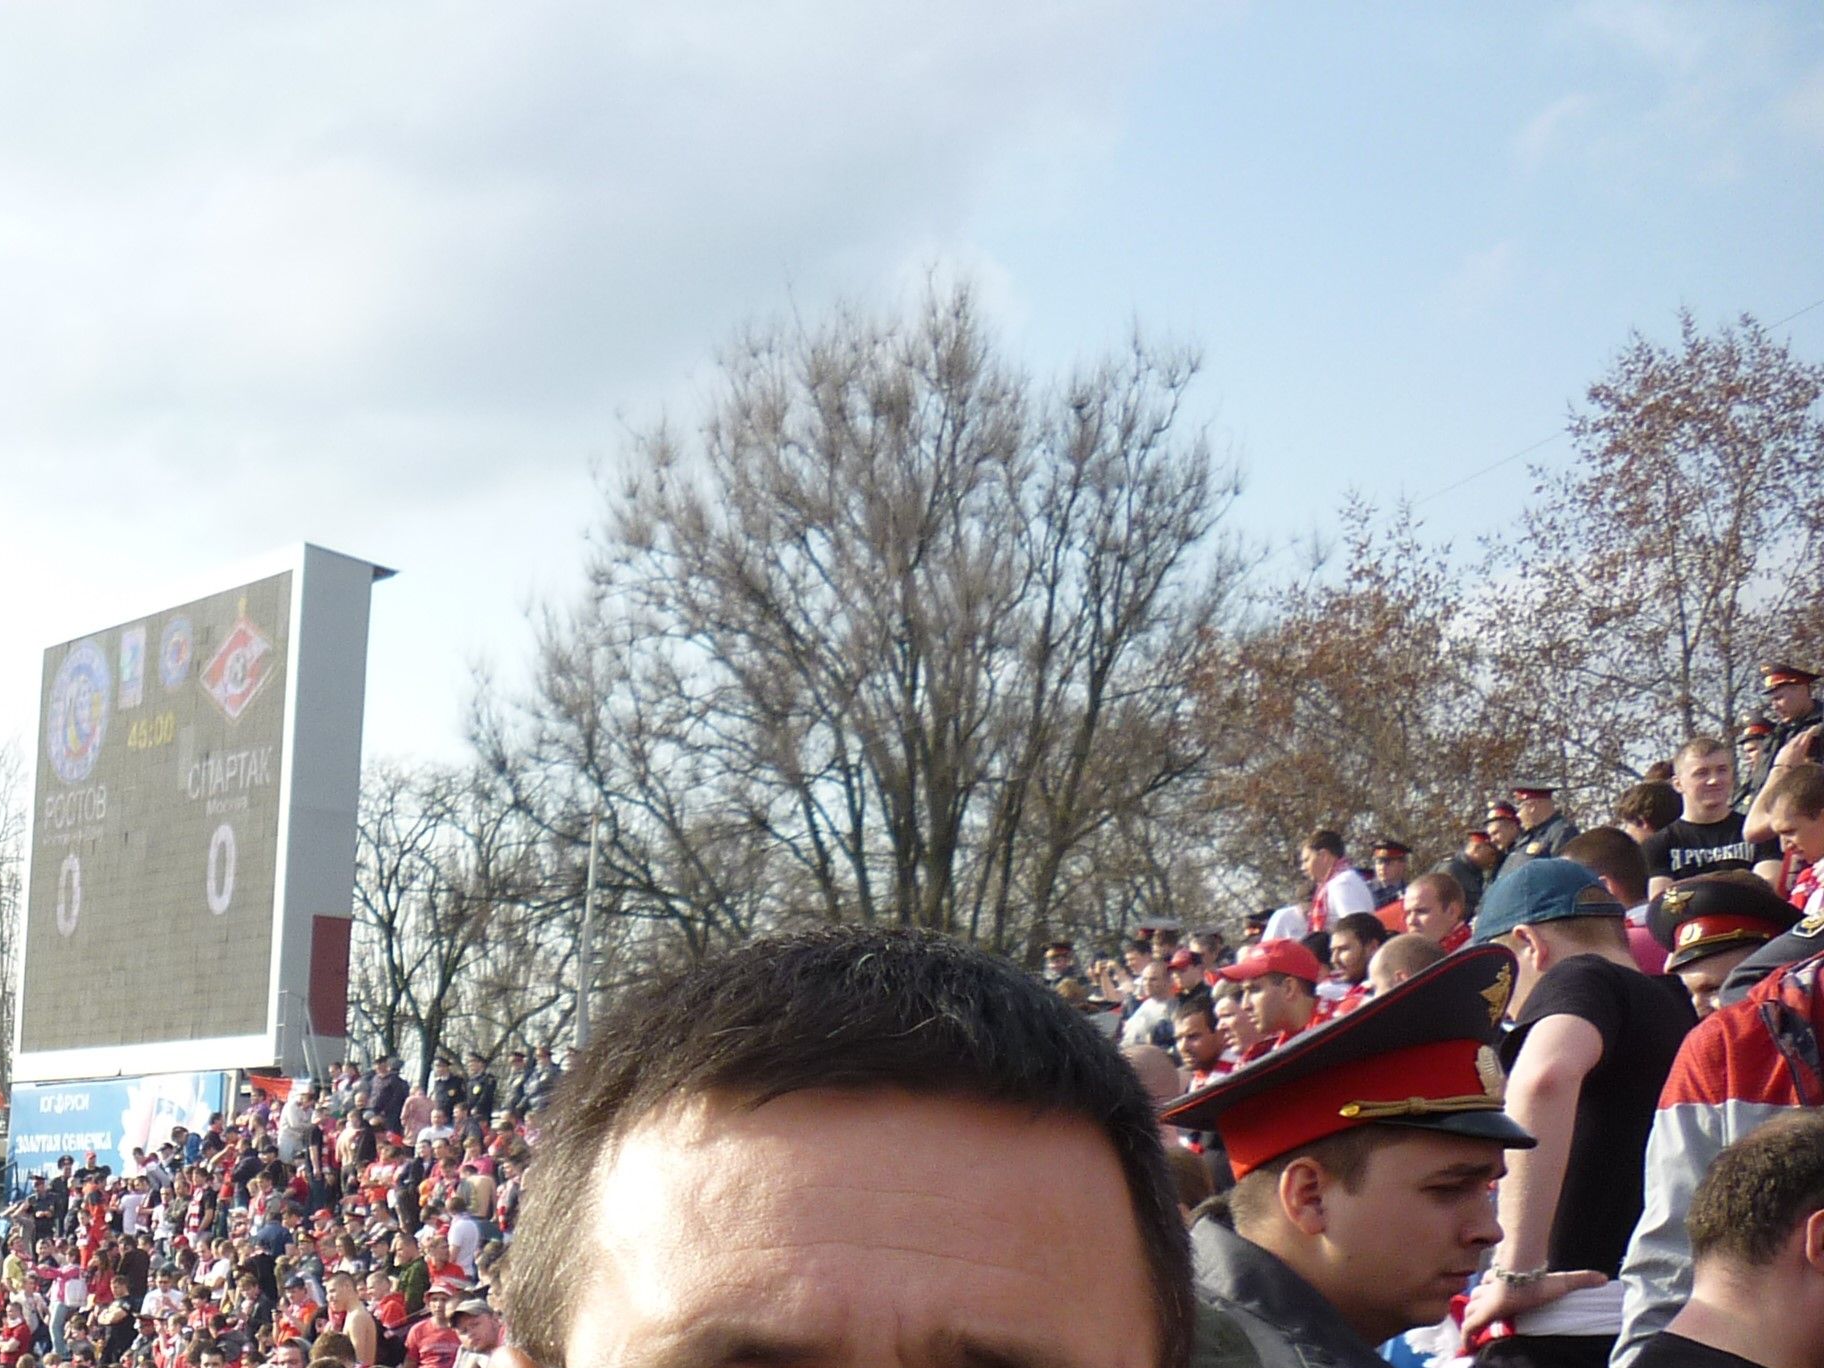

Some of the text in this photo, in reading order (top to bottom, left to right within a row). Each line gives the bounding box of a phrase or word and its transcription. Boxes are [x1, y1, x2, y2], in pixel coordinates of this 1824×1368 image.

[188, 745, 273, 799] СПАРТАК
[44, 785, 106, 829] РОСТОВ
[207, 825, 235, 915] 0
[1670, 848, 1682, 872] Я
[56, 854, 81, 938] 0
